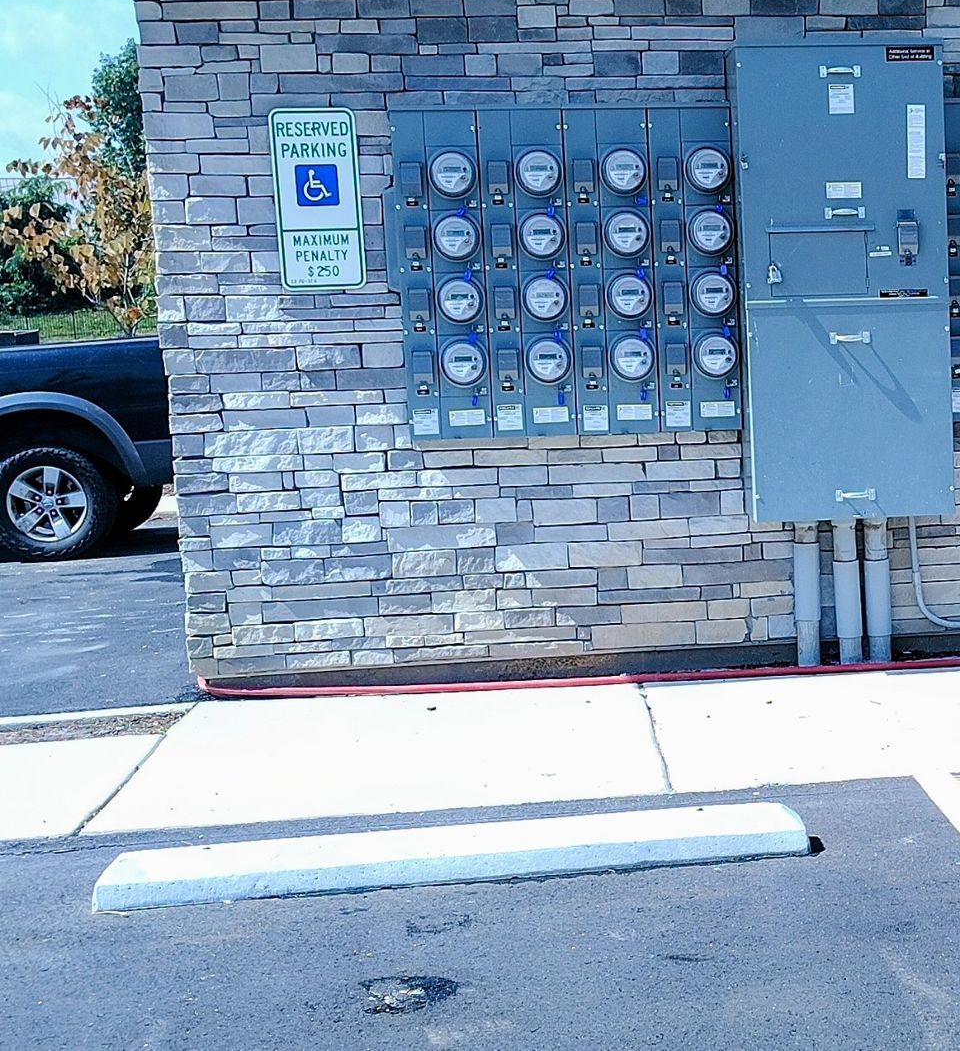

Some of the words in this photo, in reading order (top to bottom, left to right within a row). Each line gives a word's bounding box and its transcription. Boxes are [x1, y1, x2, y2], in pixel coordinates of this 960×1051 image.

[276, 121, 349, 138] RESERVED
[281, 142, 347, 158] PARKING
[293, 233, 350, 247] MAXIMUM
[295, 249, 349, 262] PENALTY
[308, 265, 340, 277] $250
